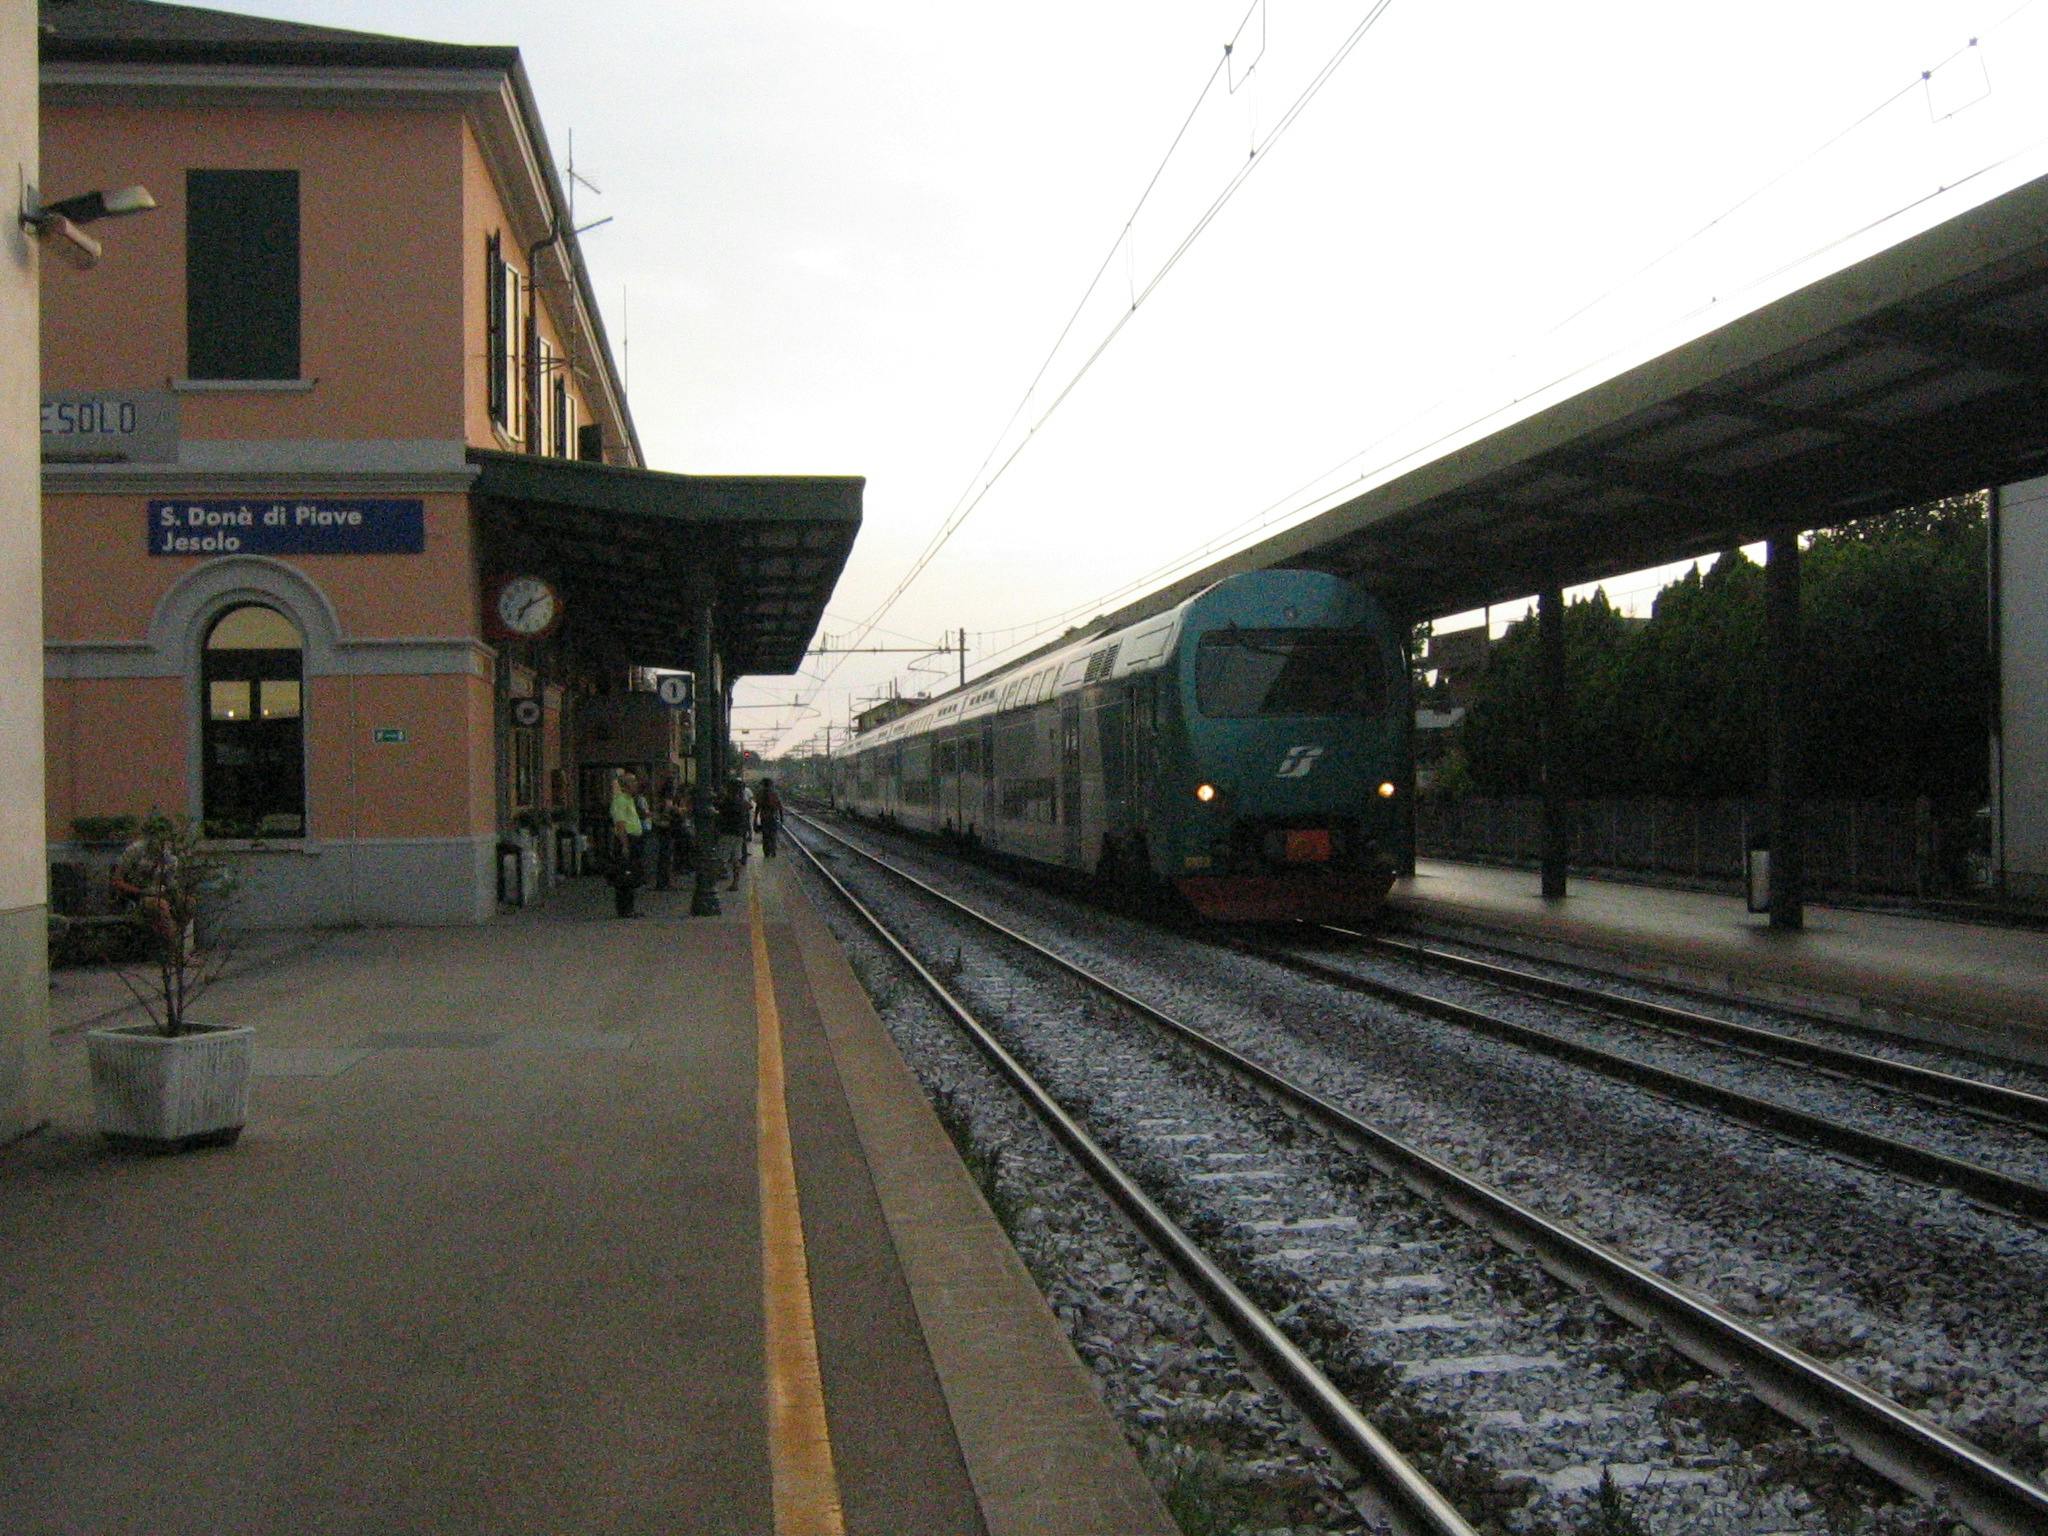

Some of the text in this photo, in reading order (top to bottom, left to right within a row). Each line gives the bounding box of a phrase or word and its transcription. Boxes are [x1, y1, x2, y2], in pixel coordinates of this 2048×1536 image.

[161, 506, 362, 526] S. Donà di Piave
[162, 531, 241, 550] Jesolo
